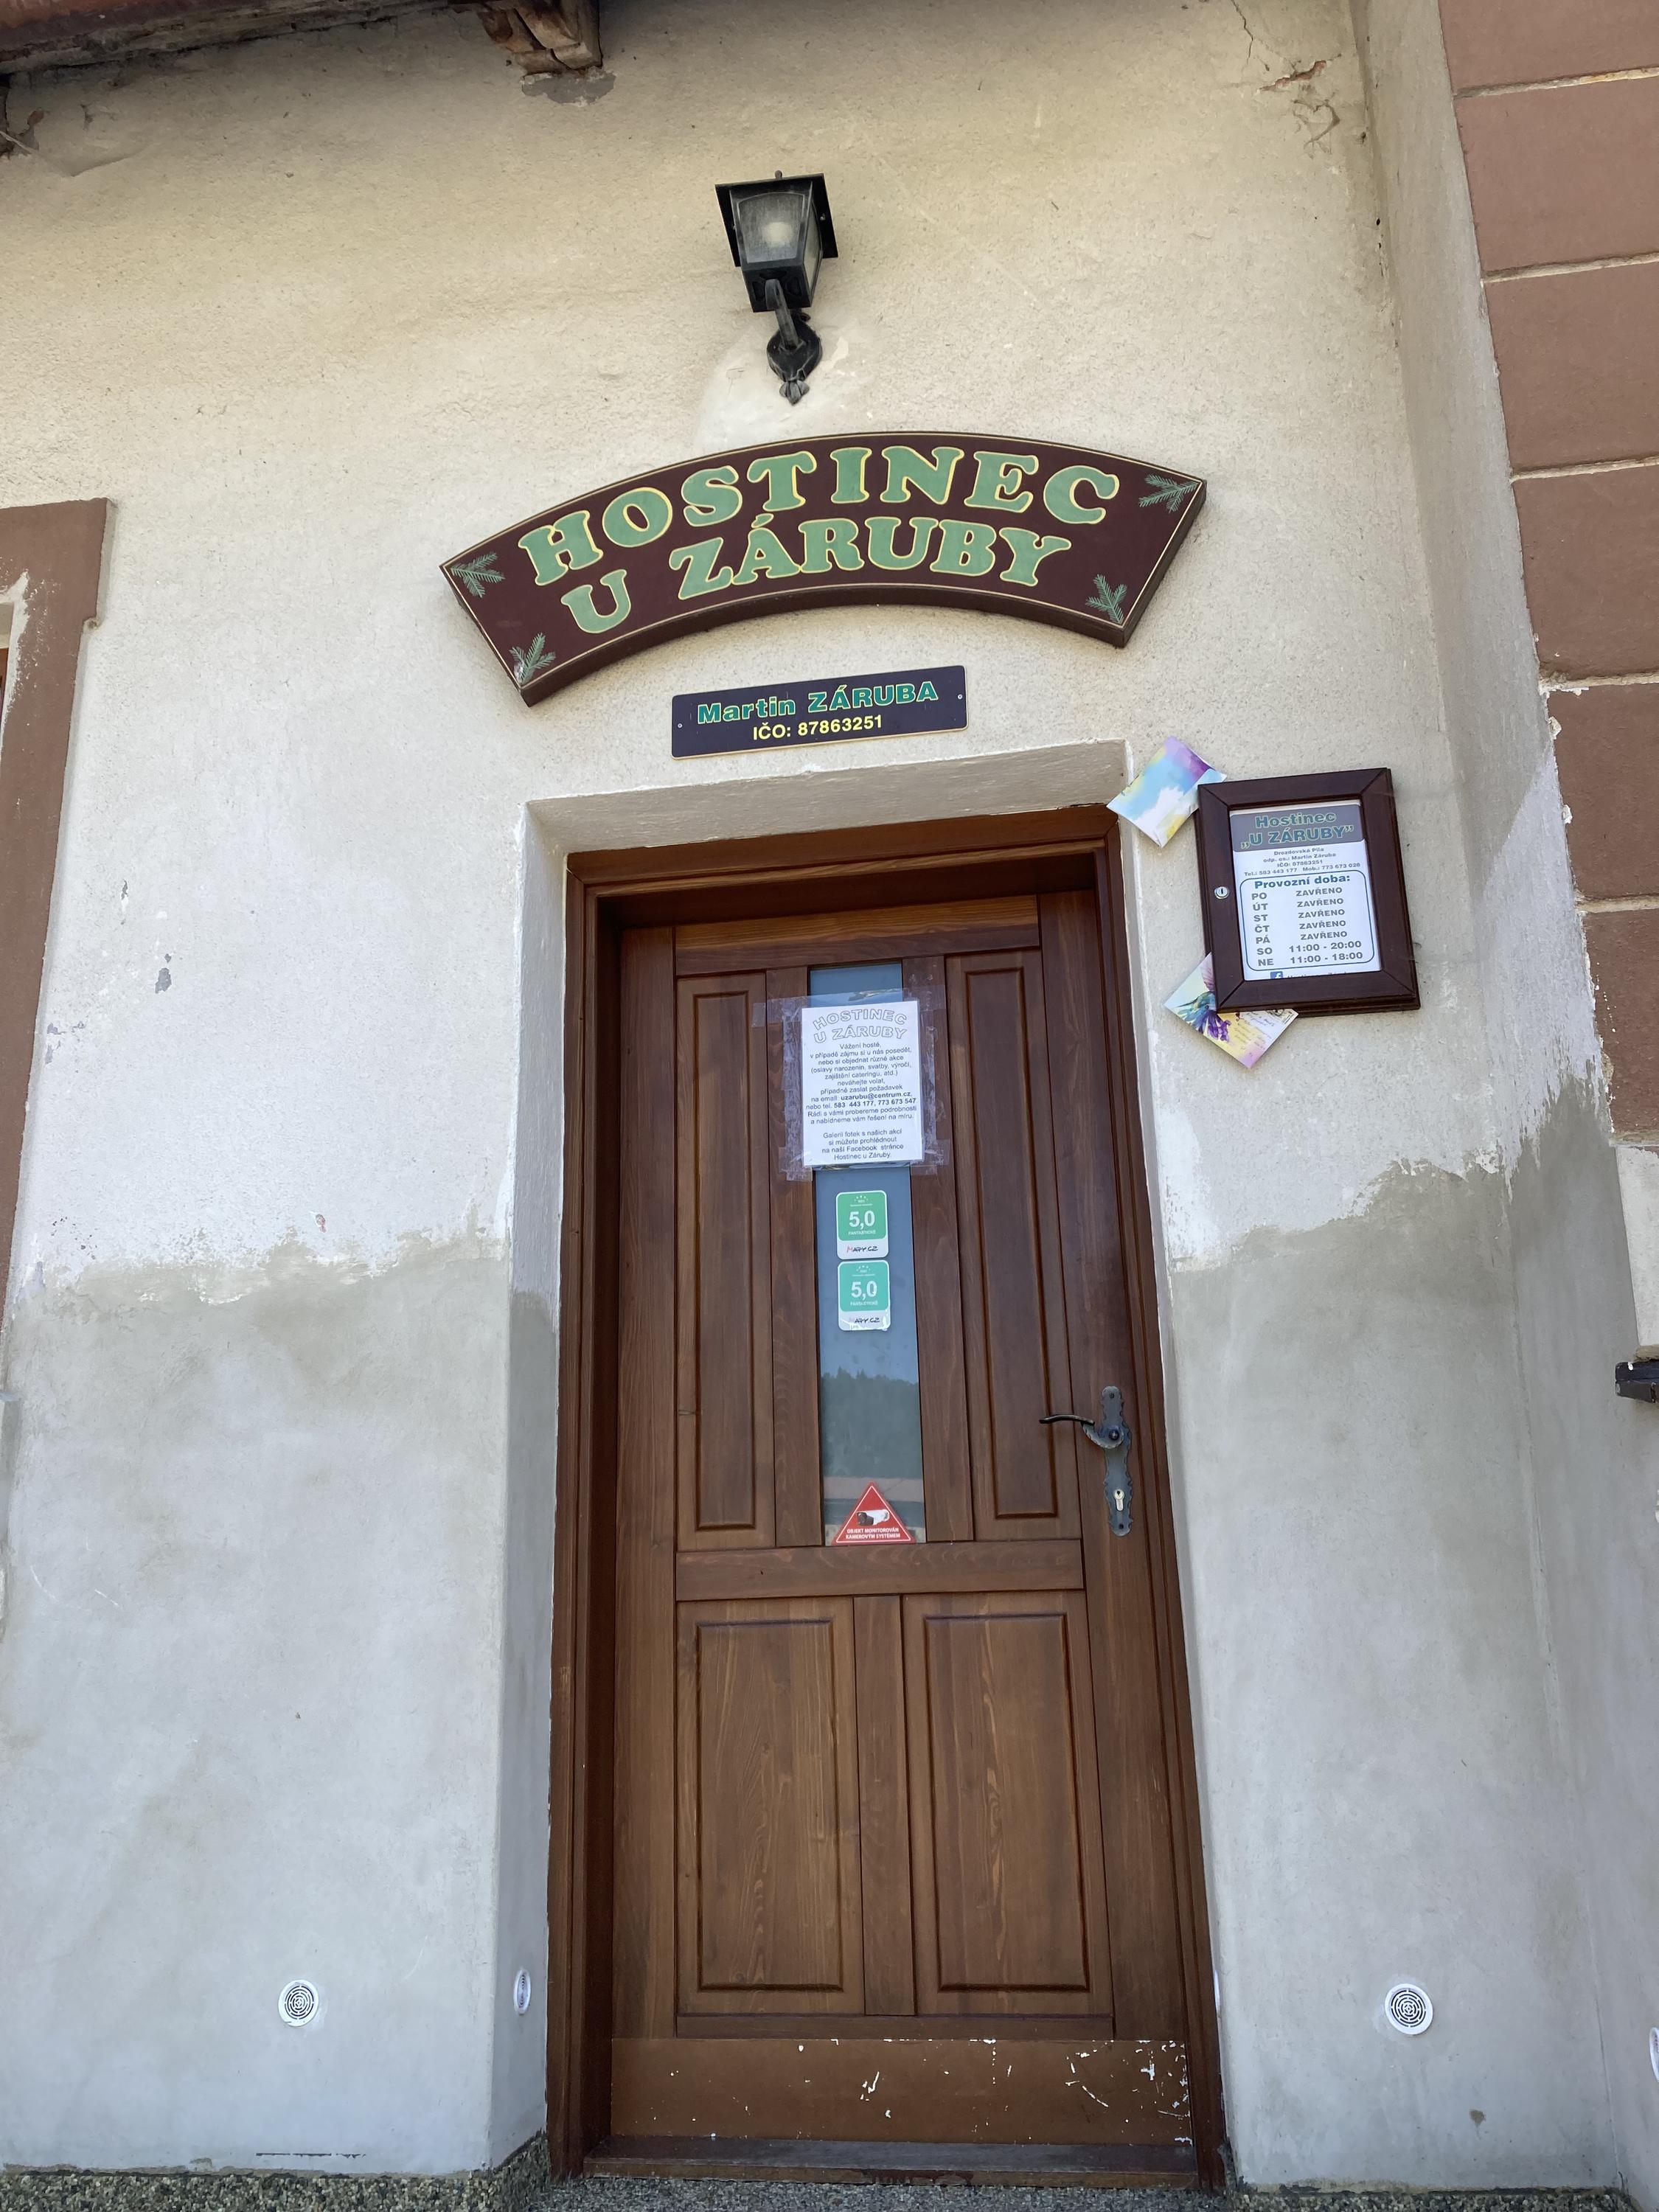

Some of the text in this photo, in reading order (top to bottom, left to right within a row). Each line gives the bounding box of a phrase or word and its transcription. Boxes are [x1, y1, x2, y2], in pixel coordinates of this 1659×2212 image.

[518, 445, 1120, 586] HOSTINEC
[560, 512, 1072, 634] U ZÁRUBY
[697, 681, 939, 725] Martin ZÁRUBA
[752, 714, 883, 741] IČO: 87863251
[1255, 812, 1337, 830] Hostinec
[1254, 874, 1351, 889] Provozní doba:
[1251, 886, 1343, 900] PO ZAVŘENO
[1252, 897, 1344, 911] ÚT ZAVŘENO
[1253, 908, 1346, 922] ST ZAVŘENO
[1254, 919, 1346, 933] ČT ZAVŘENO
[1255, 931, 1348, 945] PÁ ZAVŘENO
[1256, 947, 1273, 956] SO
[1289, 944, 1320, 953] 11:00
[1330, 940, 1362, 950] 20:00
[1258, 958, 1274, 967] NE
[1290, 955, 1321, 964] 11:00
[1332, 951, 1363, 961] 18:00
[813, 1008, 908, 1031] HOSTINEC
[813, 1024, 908, 1044] U ZÁRUBY
[815, 1051, 838, 1060] případě
[841, 1057, 869, 1065] objednat
[811, 1066, 833, 1074] (oslavy
[824, 1072, 850, 1081] zajištění
[820, 1088, 848, 1096] případně
[869, 1084, 903, 1093] požadavek
[845, 1108, 879, 1116] probereme
[880, 1105, 917, 1114] podrobnosti
[860, 1136, 897, 1145] prohlédnout
[846, 1144, 877, 1152] Facebook
[849, 1210, 875, 1230] 5,0
[850, 1280, 877, 1301] 5,0
